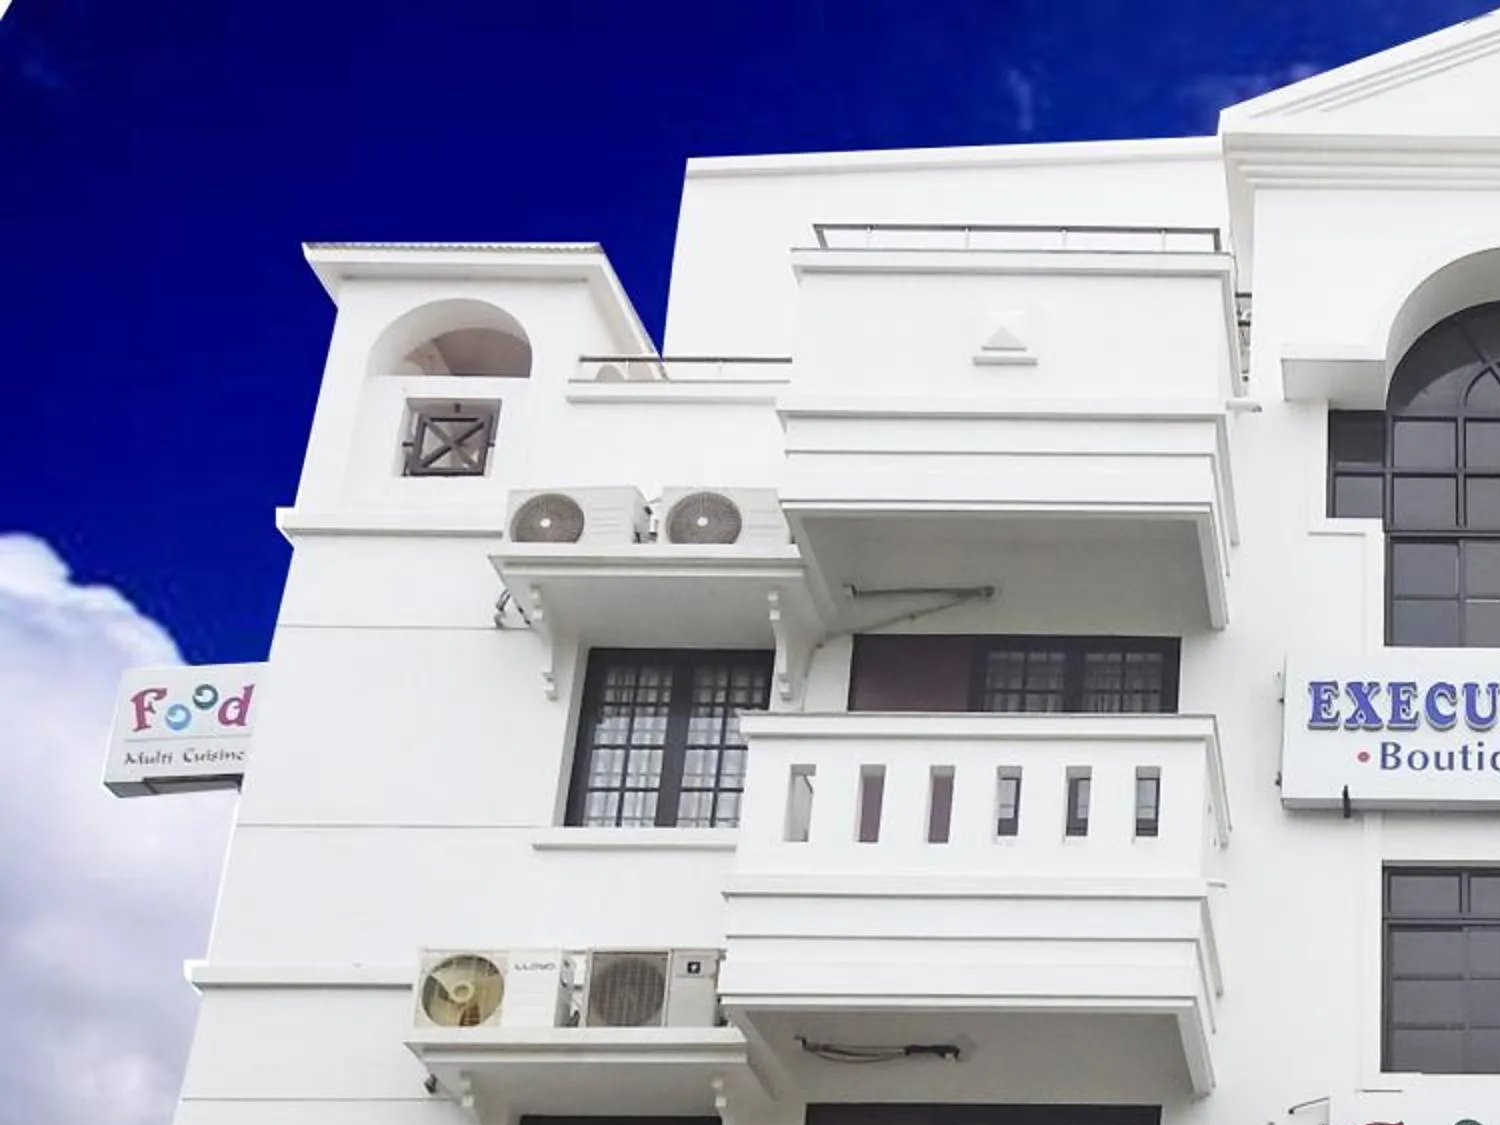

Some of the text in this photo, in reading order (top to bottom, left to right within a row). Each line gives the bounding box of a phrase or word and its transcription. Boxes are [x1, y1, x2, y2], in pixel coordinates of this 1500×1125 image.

[130, 684, 255, 732] Food
[124, 748, 246, 765] Multi Cuisine
